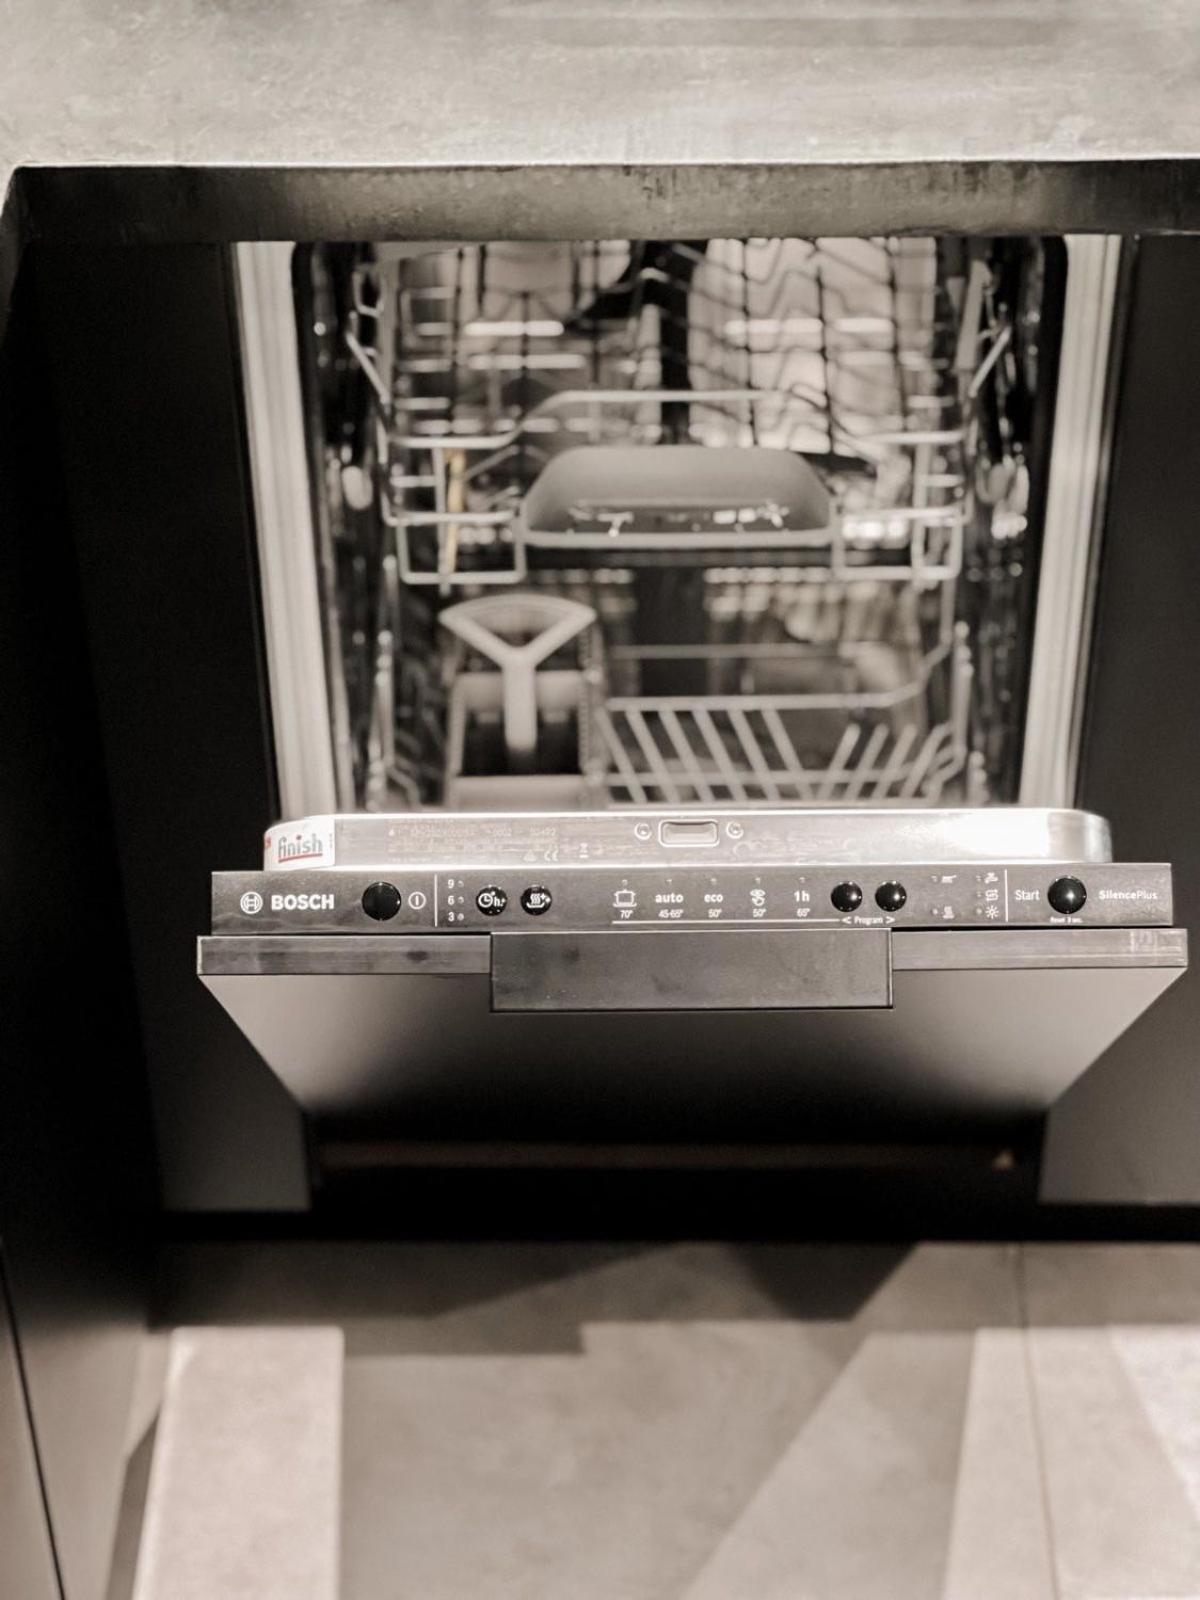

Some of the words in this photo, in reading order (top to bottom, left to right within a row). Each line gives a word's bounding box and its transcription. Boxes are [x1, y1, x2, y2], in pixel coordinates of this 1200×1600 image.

[278, 833, 323, 857] finish
[447, 879, 455, 889] 9
[447, 895, 455, 905] 6
[655, 892, 684, 903] auto
[704, 894, 723, 903] eco
[794, 890, 810, 902] 1h
[1014, 889, 1040, 901] Start
[1098, 889, 1158, 900] SilencePlus
[271, 894, 335, 910] BOSCH
[447, 911, 455, 922] 3
